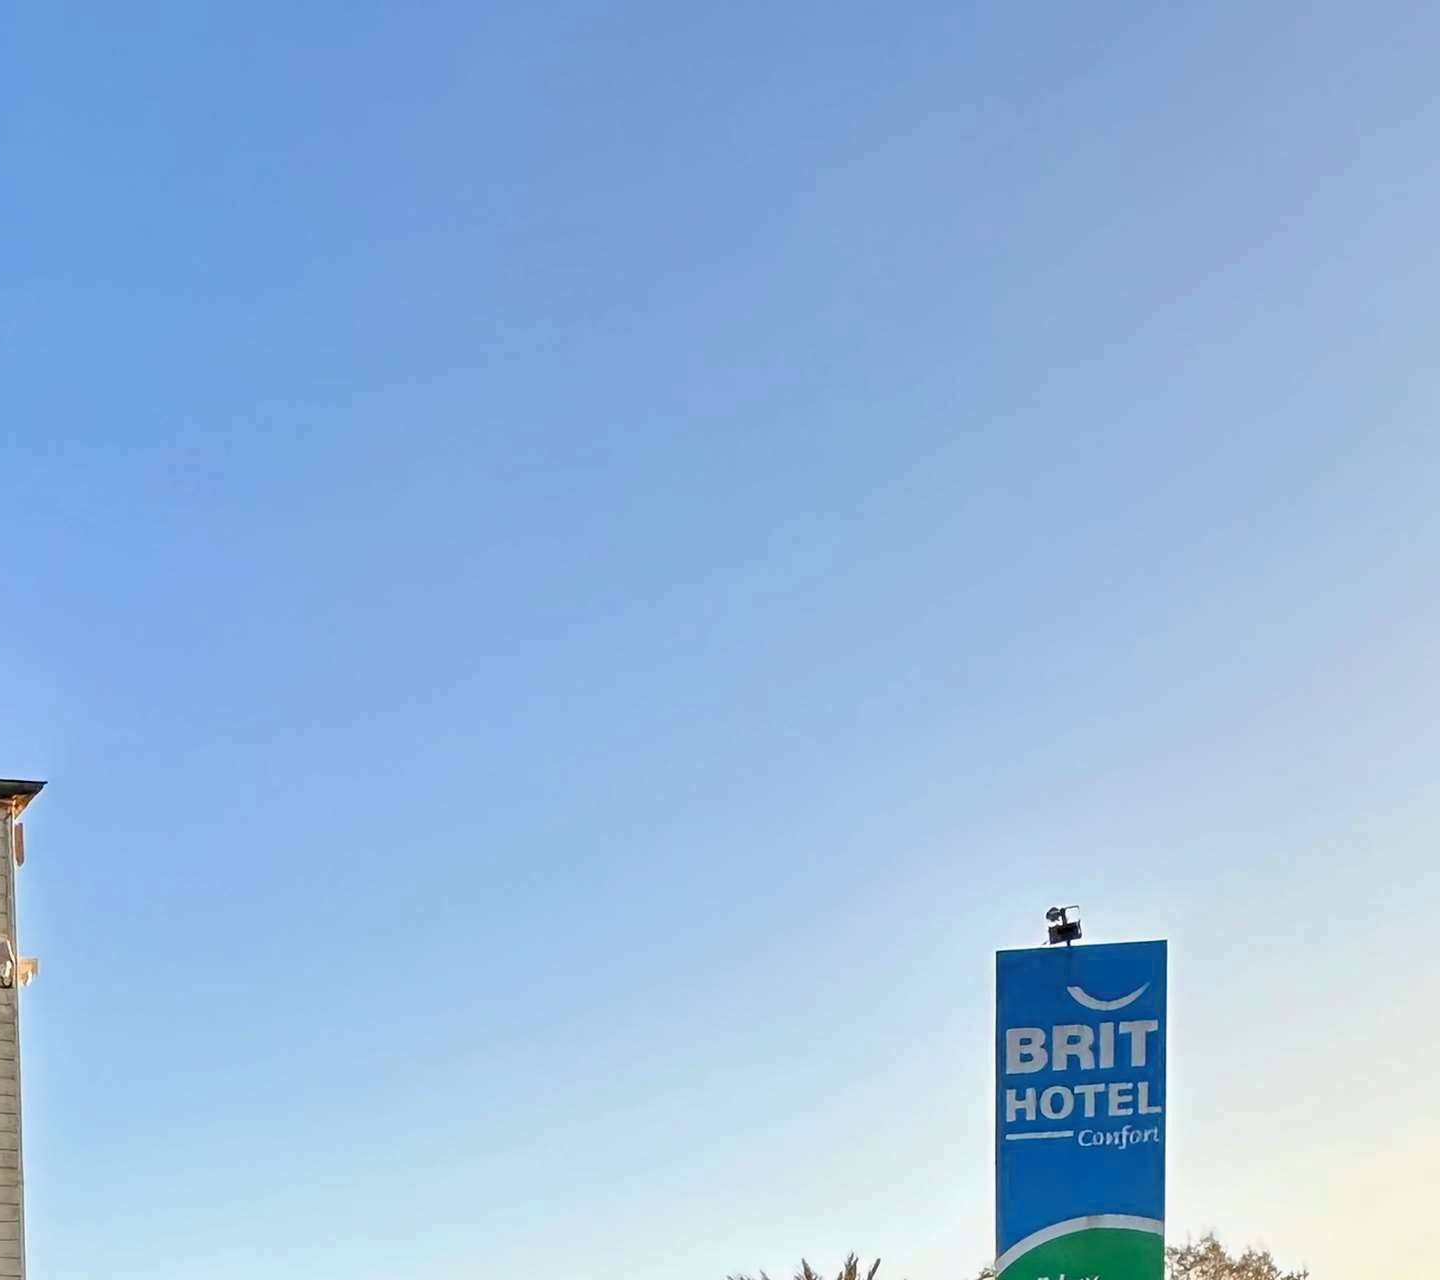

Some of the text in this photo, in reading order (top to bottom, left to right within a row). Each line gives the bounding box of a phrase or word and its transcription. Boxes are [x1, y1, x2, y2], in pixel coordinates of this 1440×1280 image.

[1006, 1019, 1159, 1075] BRIT
[1006, 1081, 1162, 1123] HOTEL
[1078, 1125, 1160, 1150] Confort
